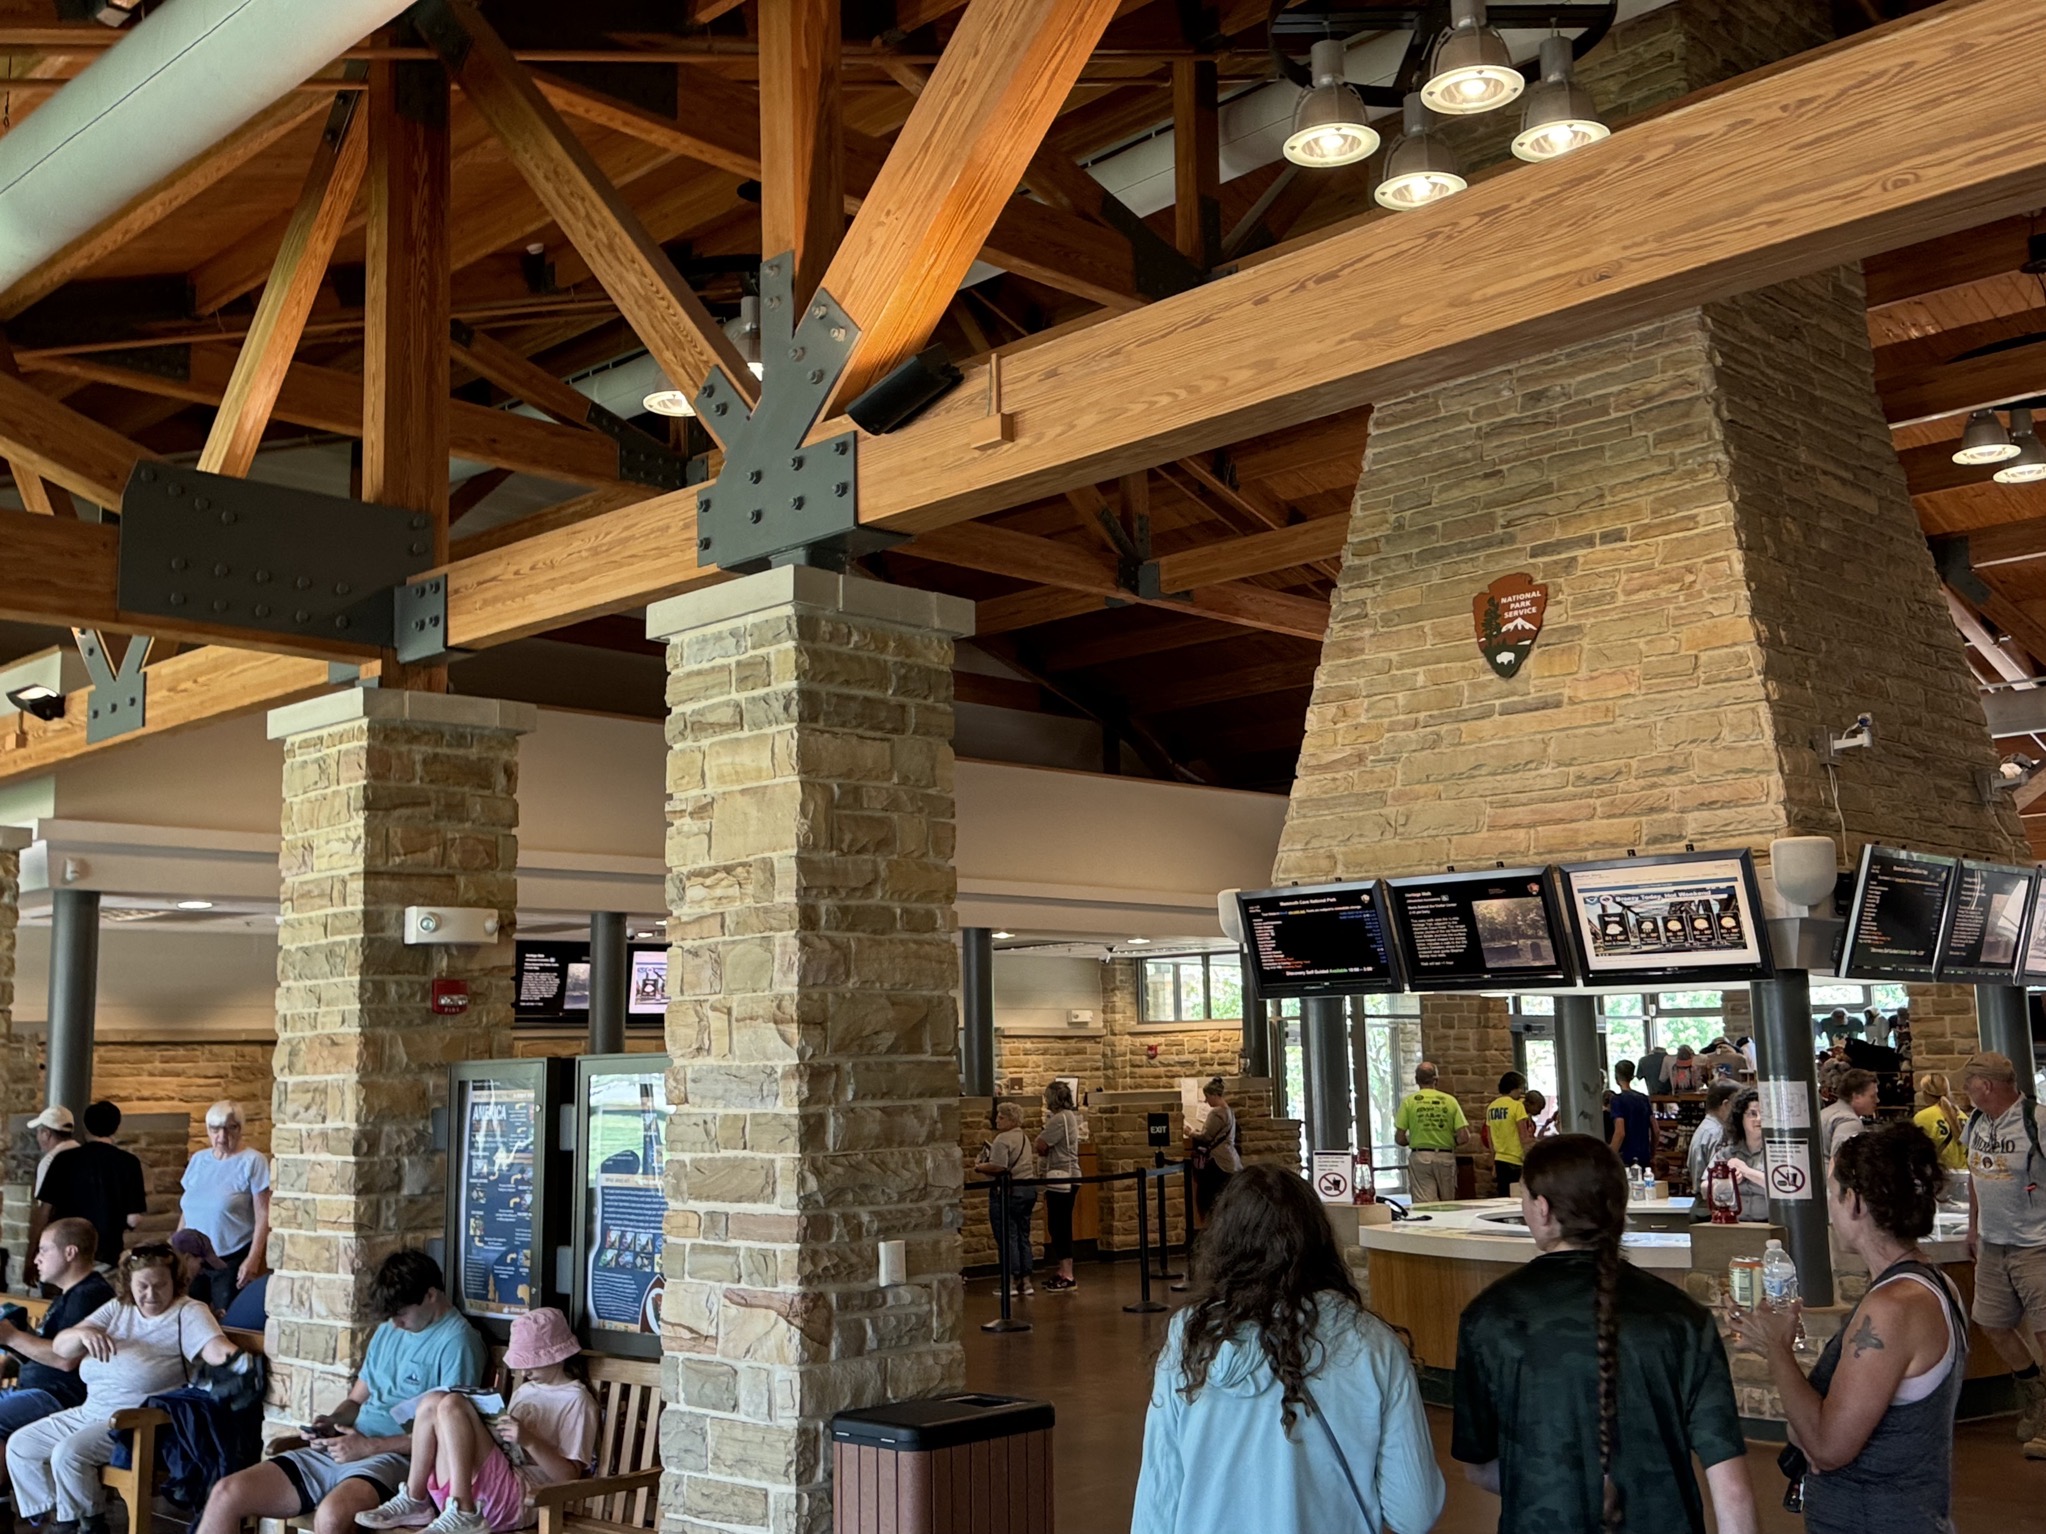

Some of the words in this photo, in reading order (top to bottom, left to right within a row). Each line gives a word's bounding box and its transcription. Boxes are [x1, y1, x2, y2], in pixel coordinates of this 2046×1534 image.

[1501, 591, 1541, 603] NATIONAL
[1510, 600, 1531, 610] PARK
[1504, 606, 1537, 618] SERVICE
[1150, 1125, 1167, 1134] EXIT
